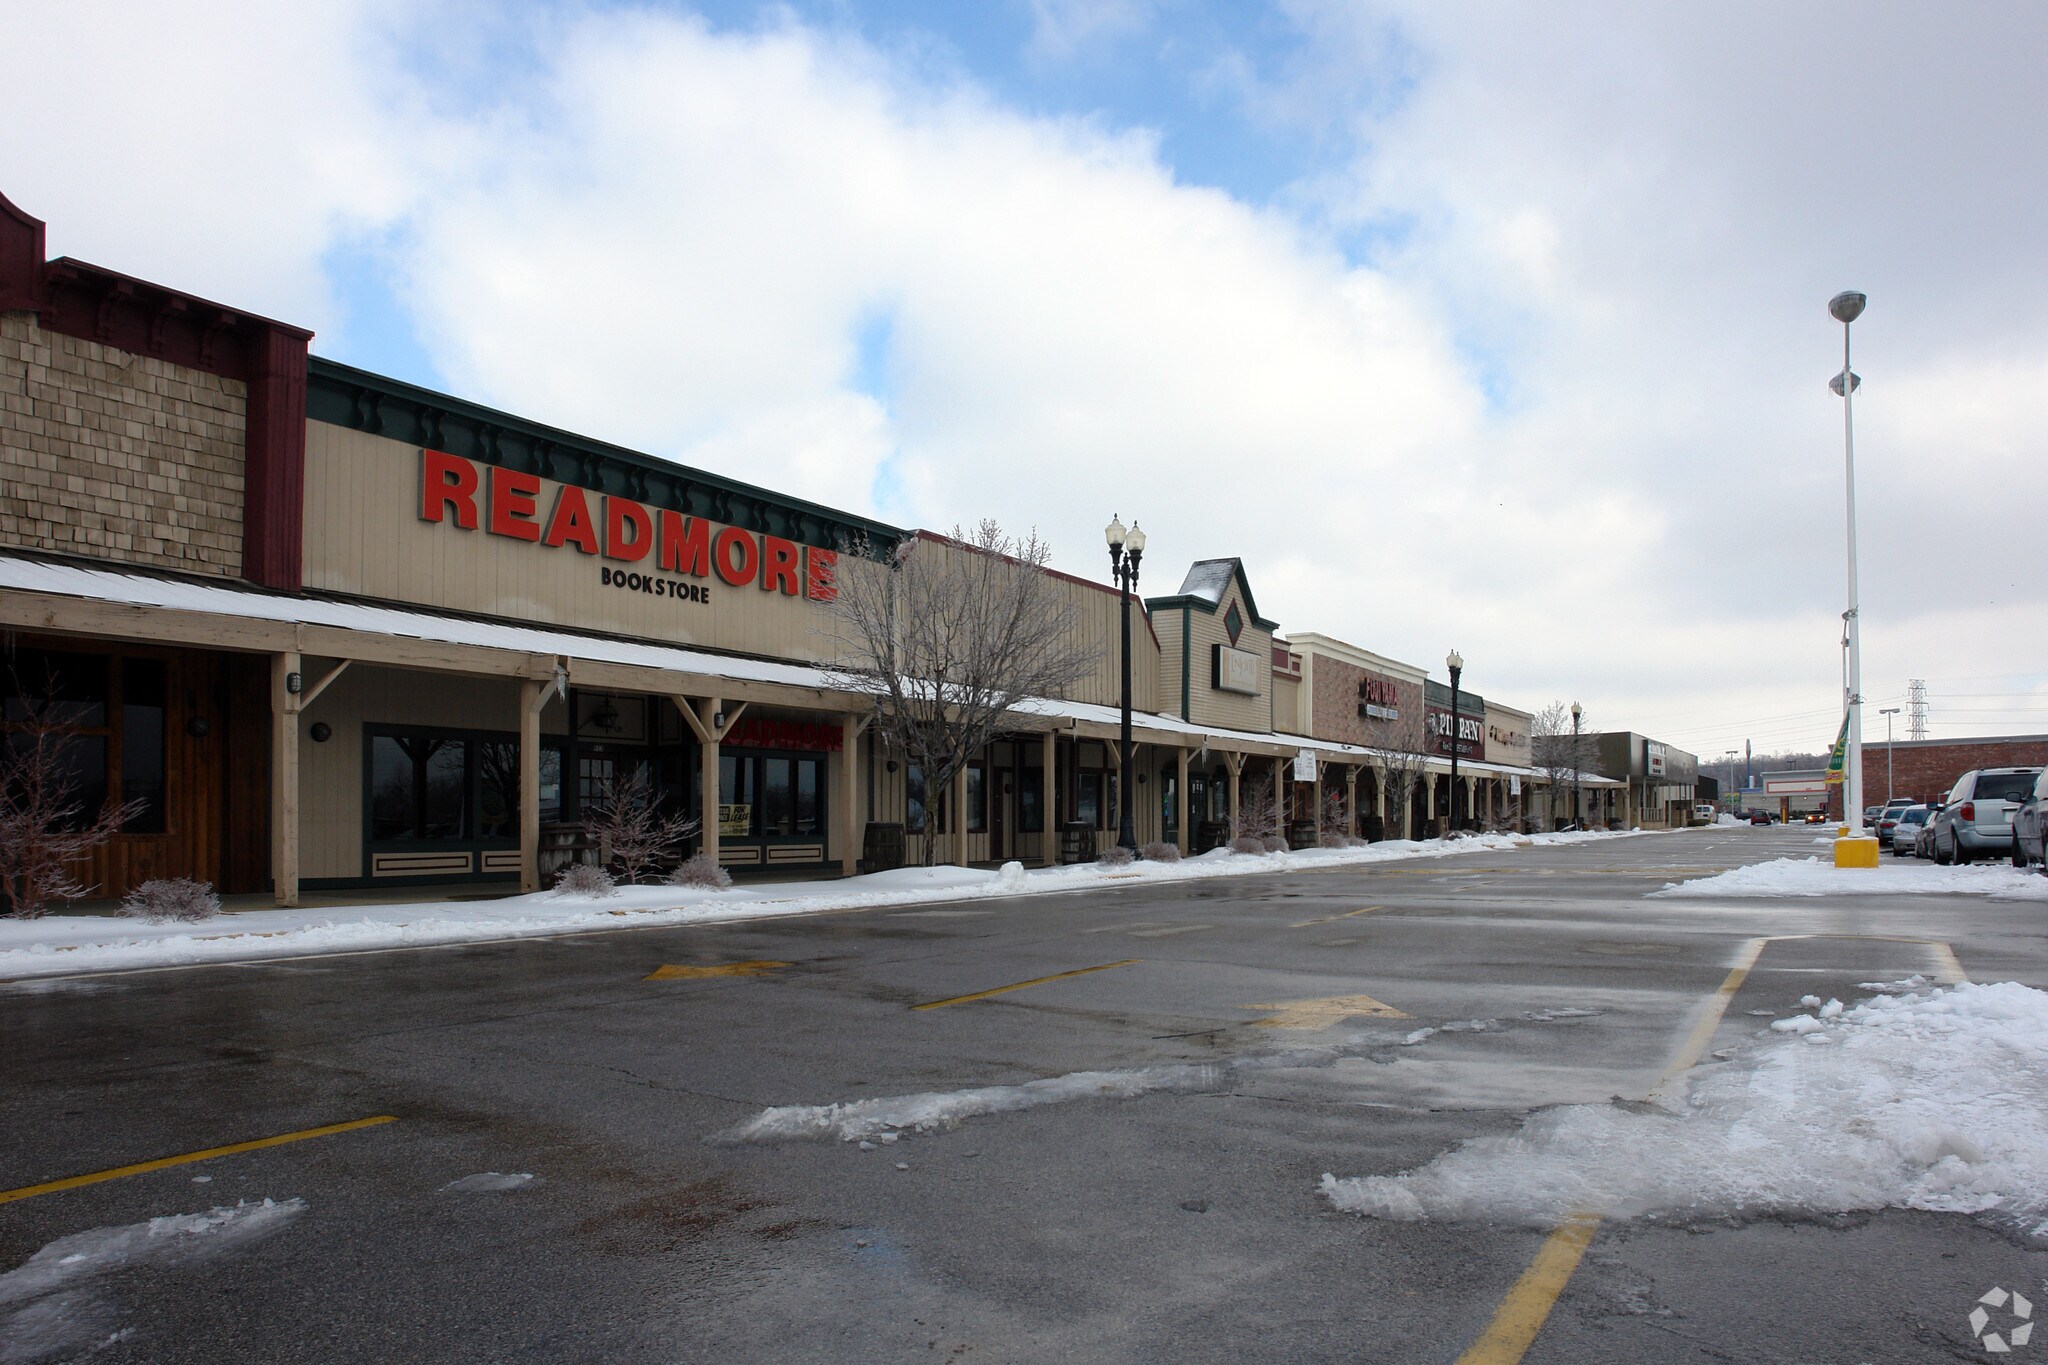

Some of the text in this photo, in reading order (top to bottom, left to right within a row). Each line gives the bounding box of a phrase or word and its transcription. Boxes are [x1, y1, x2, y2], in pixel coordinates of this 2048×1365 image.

[418, 449, 838, 601] READMORE
[601, 566, 710, 604] BOOKSTORE
[720, 718, 843, 752] EADMORE
[1458, 717, 1479, 741] PAN
